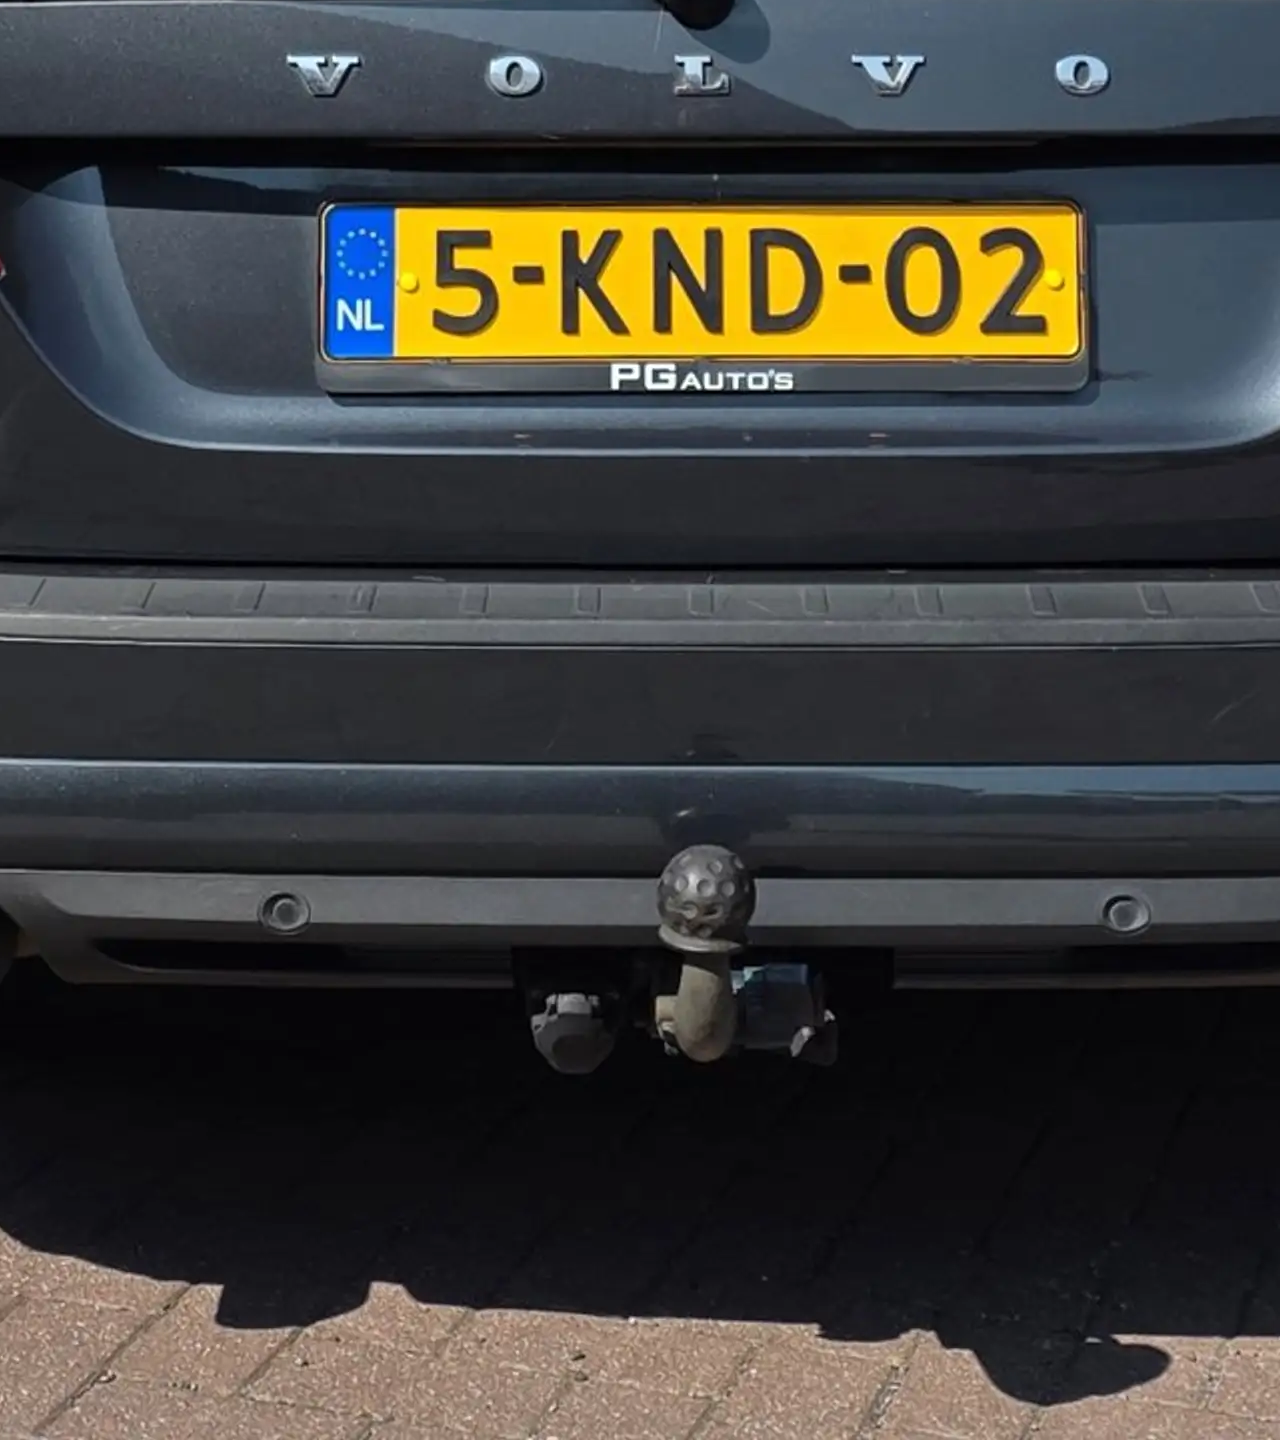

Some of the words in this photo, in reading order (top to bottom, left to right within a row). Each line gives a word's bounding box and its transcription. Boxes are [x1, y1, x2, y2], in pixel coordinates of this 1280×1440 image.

[287, 54, 1111, 97] VOLVO
[431, 226, 1048, 337] 5-KND-02
[336, 300, 384, 333] NL
